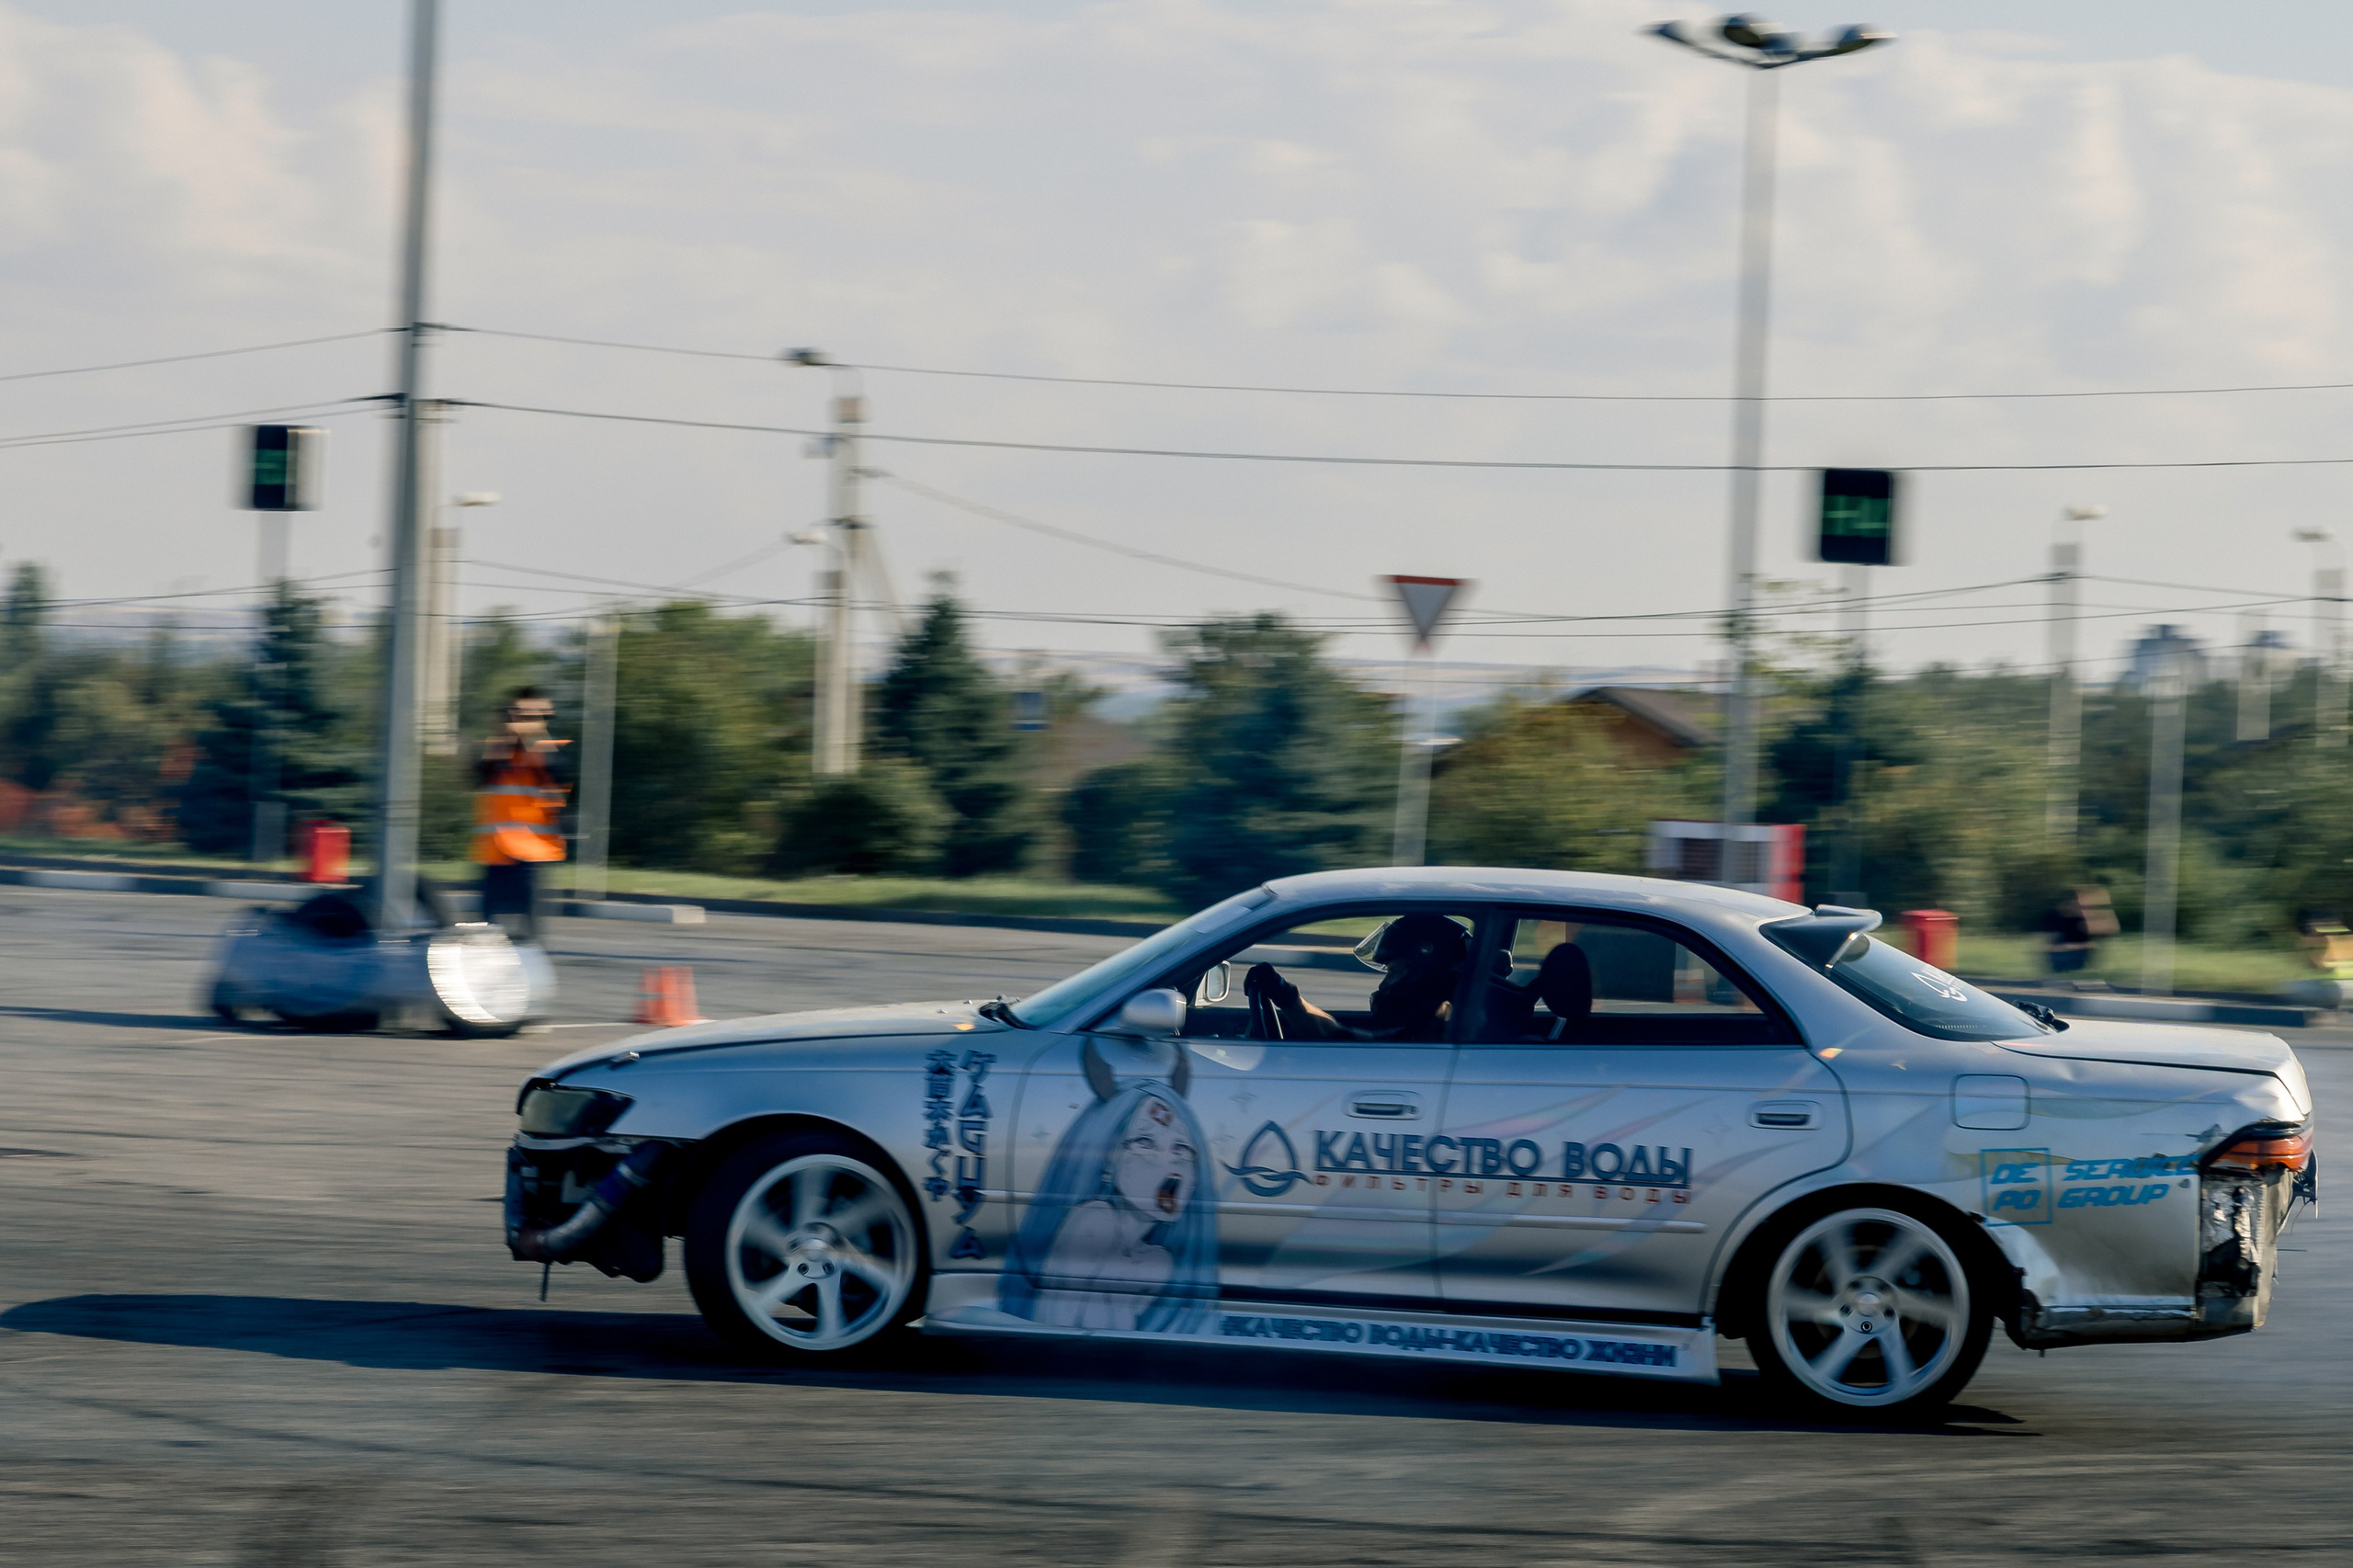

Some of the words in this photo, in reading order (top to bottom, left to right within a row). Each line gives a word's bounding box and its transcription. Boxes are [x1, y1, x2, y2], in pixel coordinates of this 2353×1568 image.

[1313, 1130, 1541, 1176] КАЧЕСТВО
[1563, 1142, 1693, 1184] ВОДЫ
[1990, 1162, 2042, 1185] DE
[1313, 1174, 1483, 1195] ФИЛЬТРЫ
[1505, 1182, 1573, 1199] ДЛЯ
[1593, 1186, 1692, 1204] ВОДЫ
[2057, 1184, 2169, 1209] GROUP
